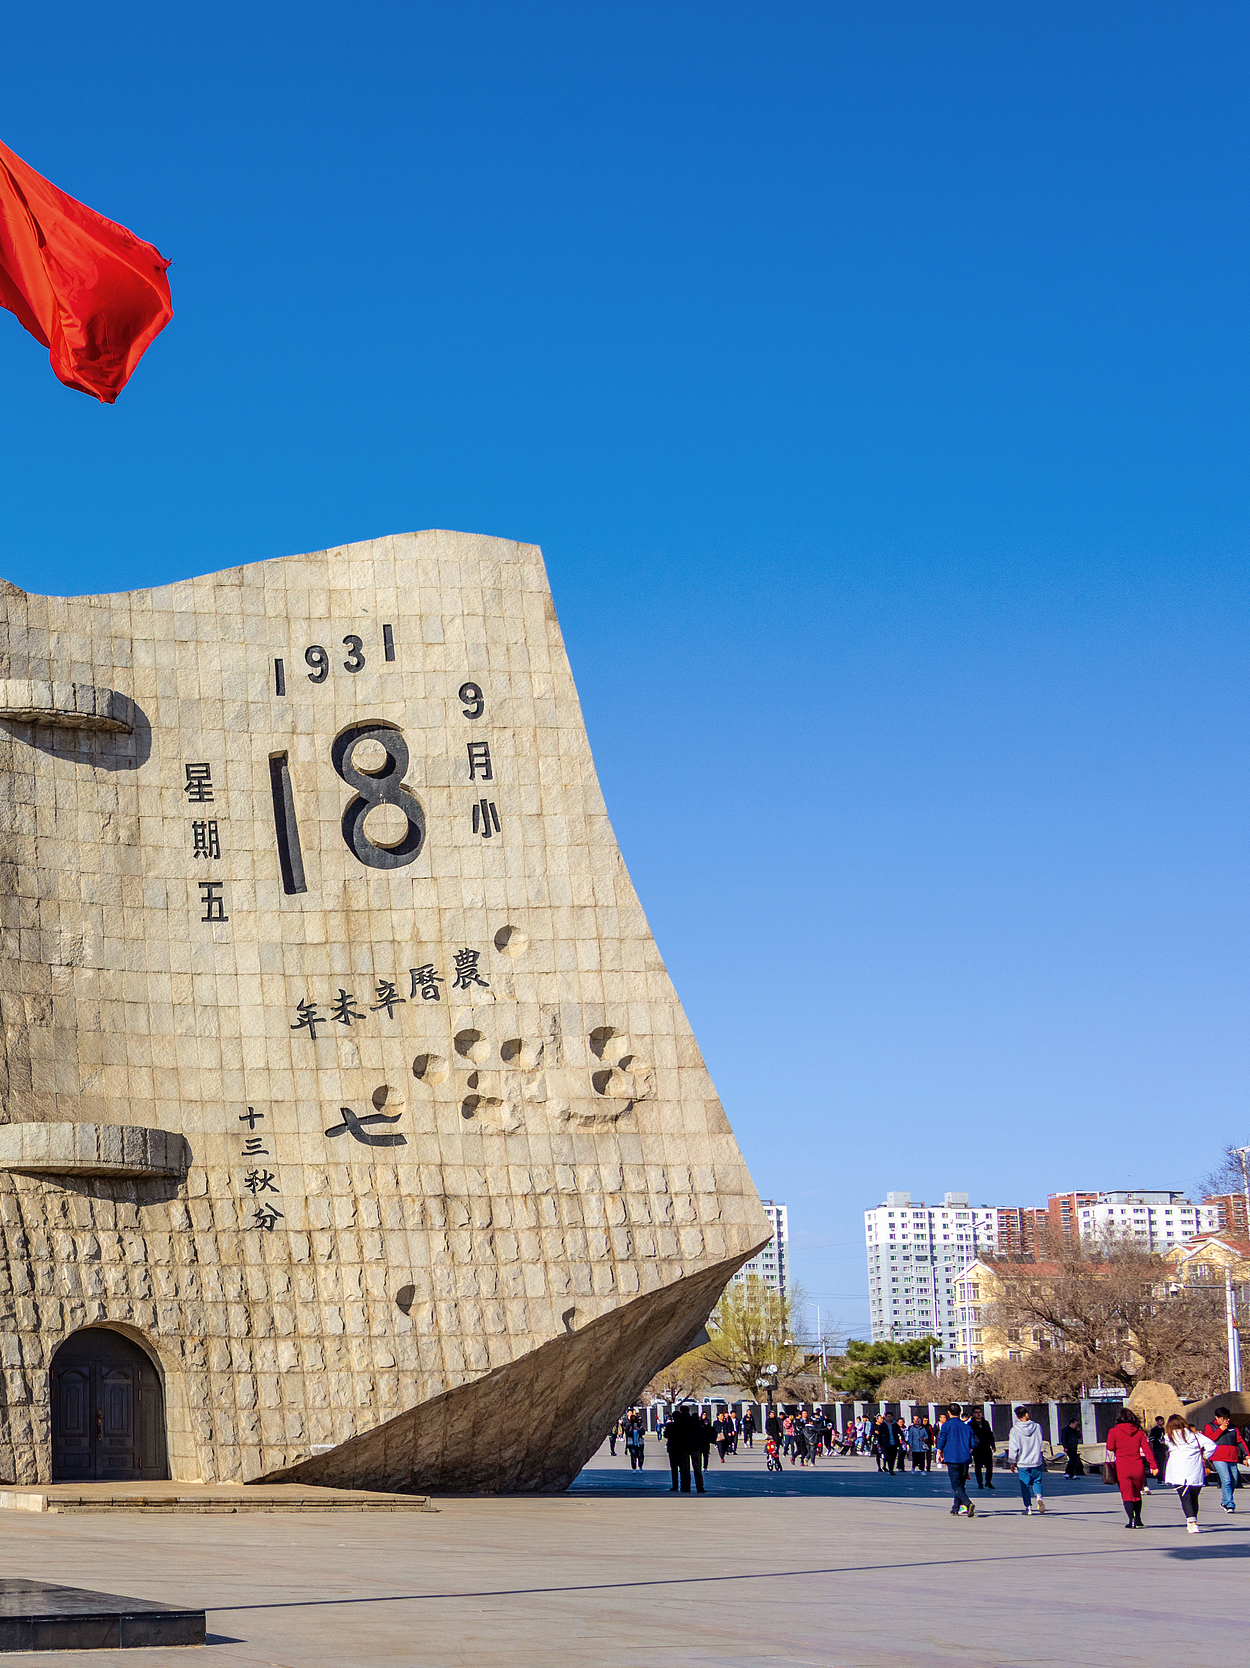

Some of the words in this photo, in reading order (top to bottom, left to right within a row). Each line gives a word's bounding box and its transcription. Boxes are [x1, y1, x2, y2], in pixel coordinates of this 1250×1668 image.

[274, 624, 396, 696] 1931
[184, 762, 229, 922] 星期五
[268, 718, 427, 895] 18
[324, 1107, 409, 1147] 七
